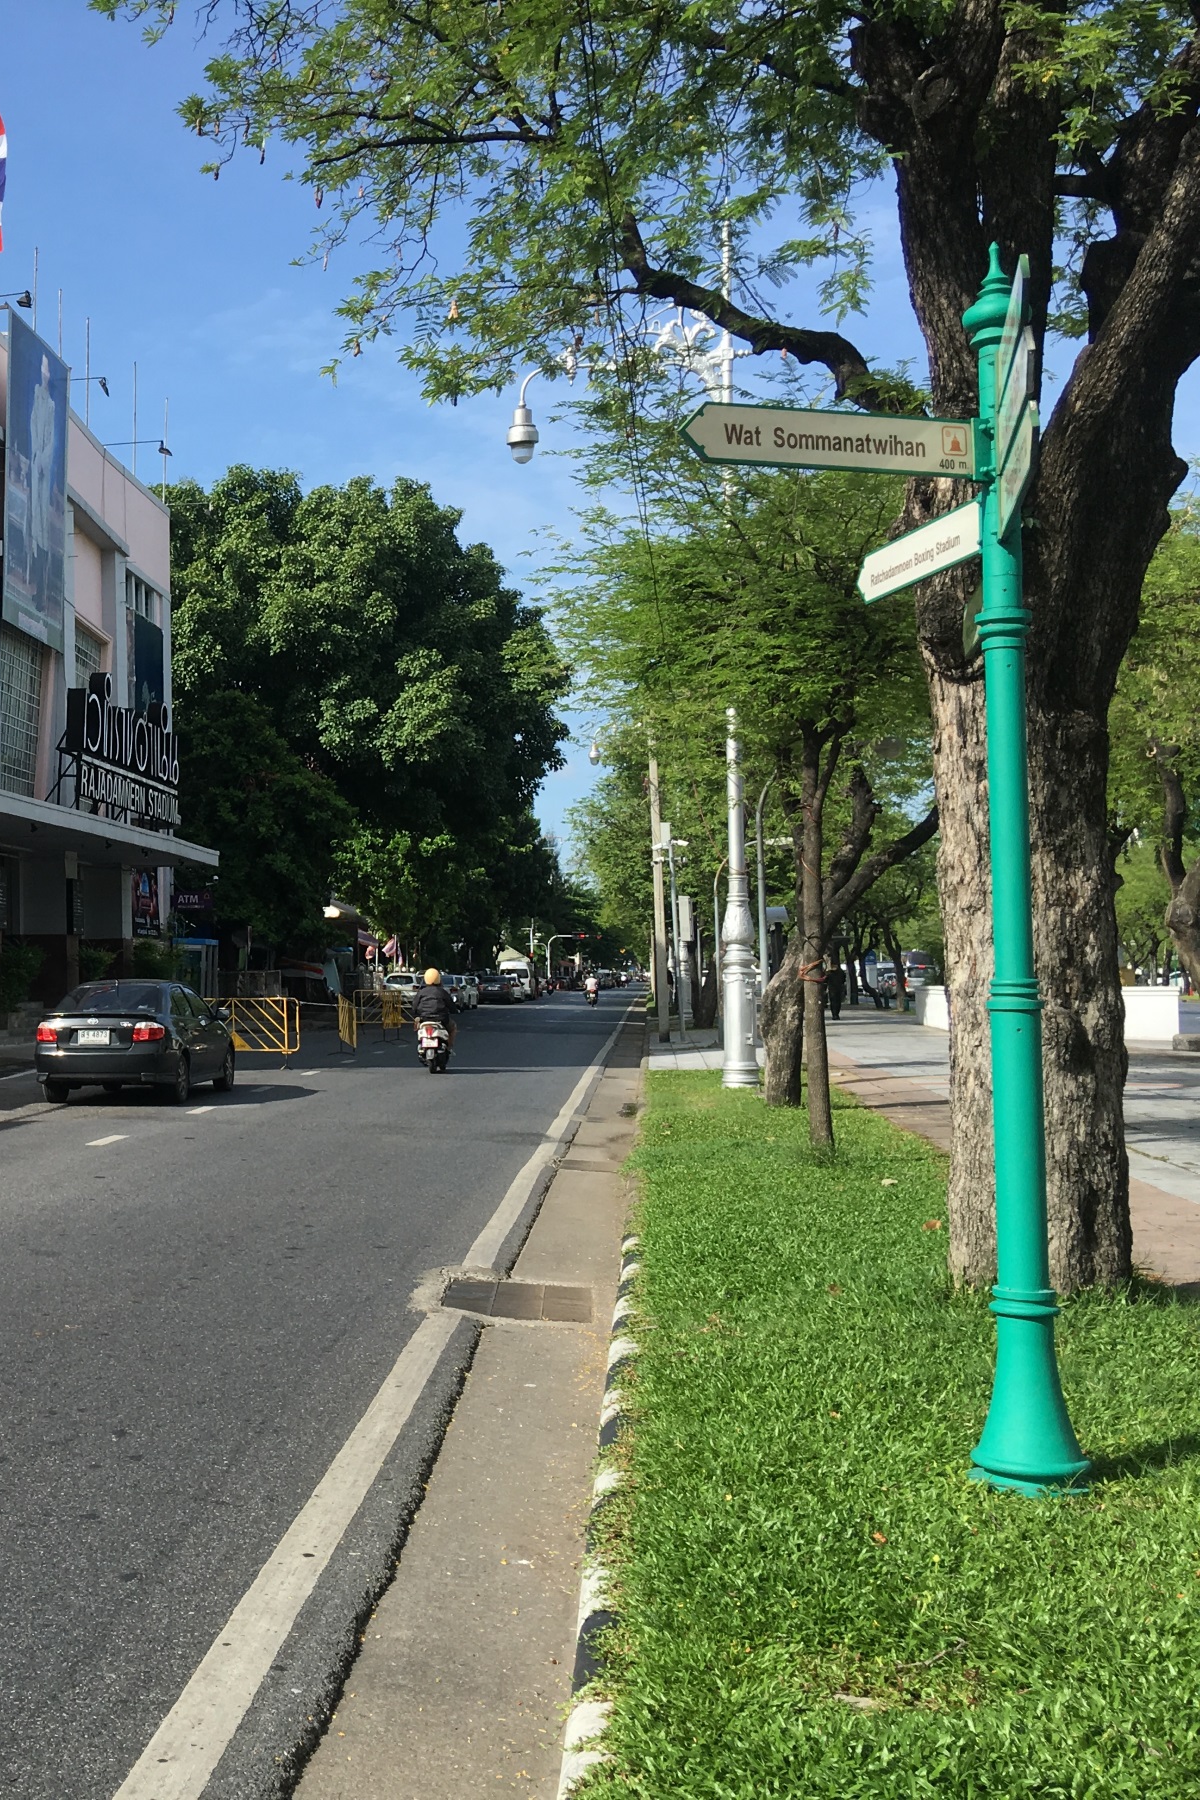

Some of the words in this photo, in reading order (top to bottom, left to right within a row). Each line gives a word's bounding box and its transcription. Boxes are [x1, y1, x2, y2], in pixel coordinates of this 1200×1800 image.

[724, 423, 762, 448] Wat
[773, 427, 927, 459] Sommanatwihan
[939, 458, 956, 470] 400
[870, 558, 913, 587] Ratchadamnoen
[913, 547, 935, 566] Boxing
[935, 534, 961, 556] Stadium
[80, 765, 146, 814] RAJADAMNERN
[148, 788, 180, 824] STADIUM
[177, 894, 199, 904] ATM
